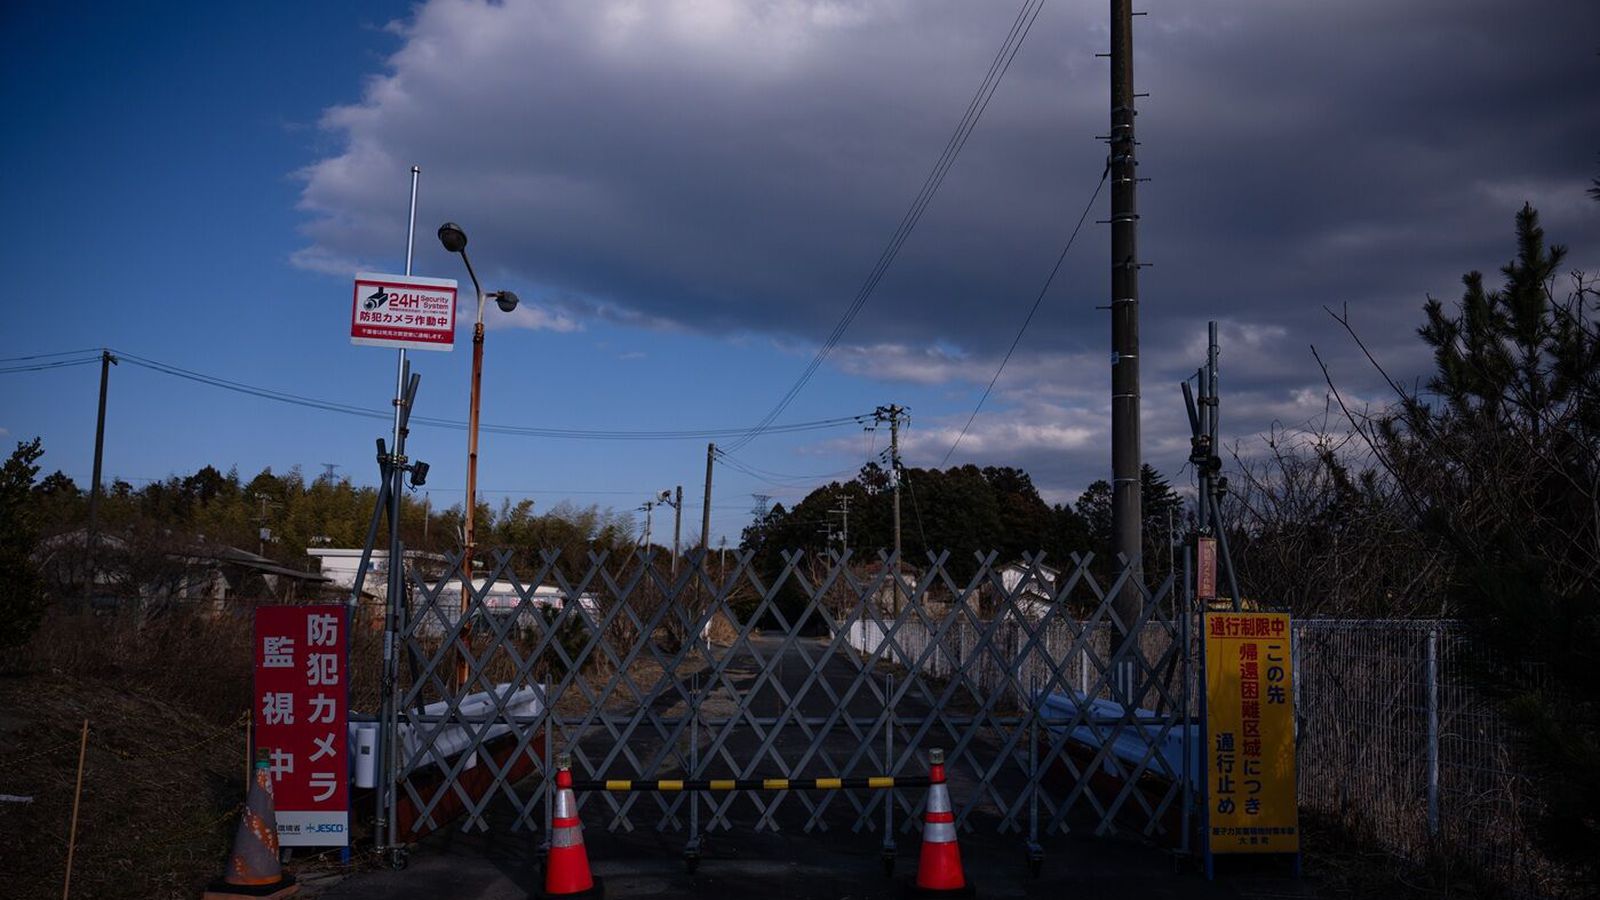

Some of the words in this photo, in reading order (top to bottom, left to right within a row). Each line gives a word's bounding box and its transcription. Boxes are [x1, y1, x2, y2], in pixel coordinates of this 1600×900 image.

[389, 293, 419, 308] 24H
[421, 295, 449, 304] Security
[423, 302, 449, 310] System
[360, 311, 448, 327] 防犯カメラ作動中
[1210, 617, 1285, 636] 通行制限中
[1267, 645, 1286, 704] この先
[262, 636, 295, 781] 監視中
[306, 613, 339, 802] 防犯カメラ
[1240, 643, 1262, 815] 帰還困難区域につき
[1216, 732, 1236, 815] 通行止め
[315, 824, 344, 833] JESCO
